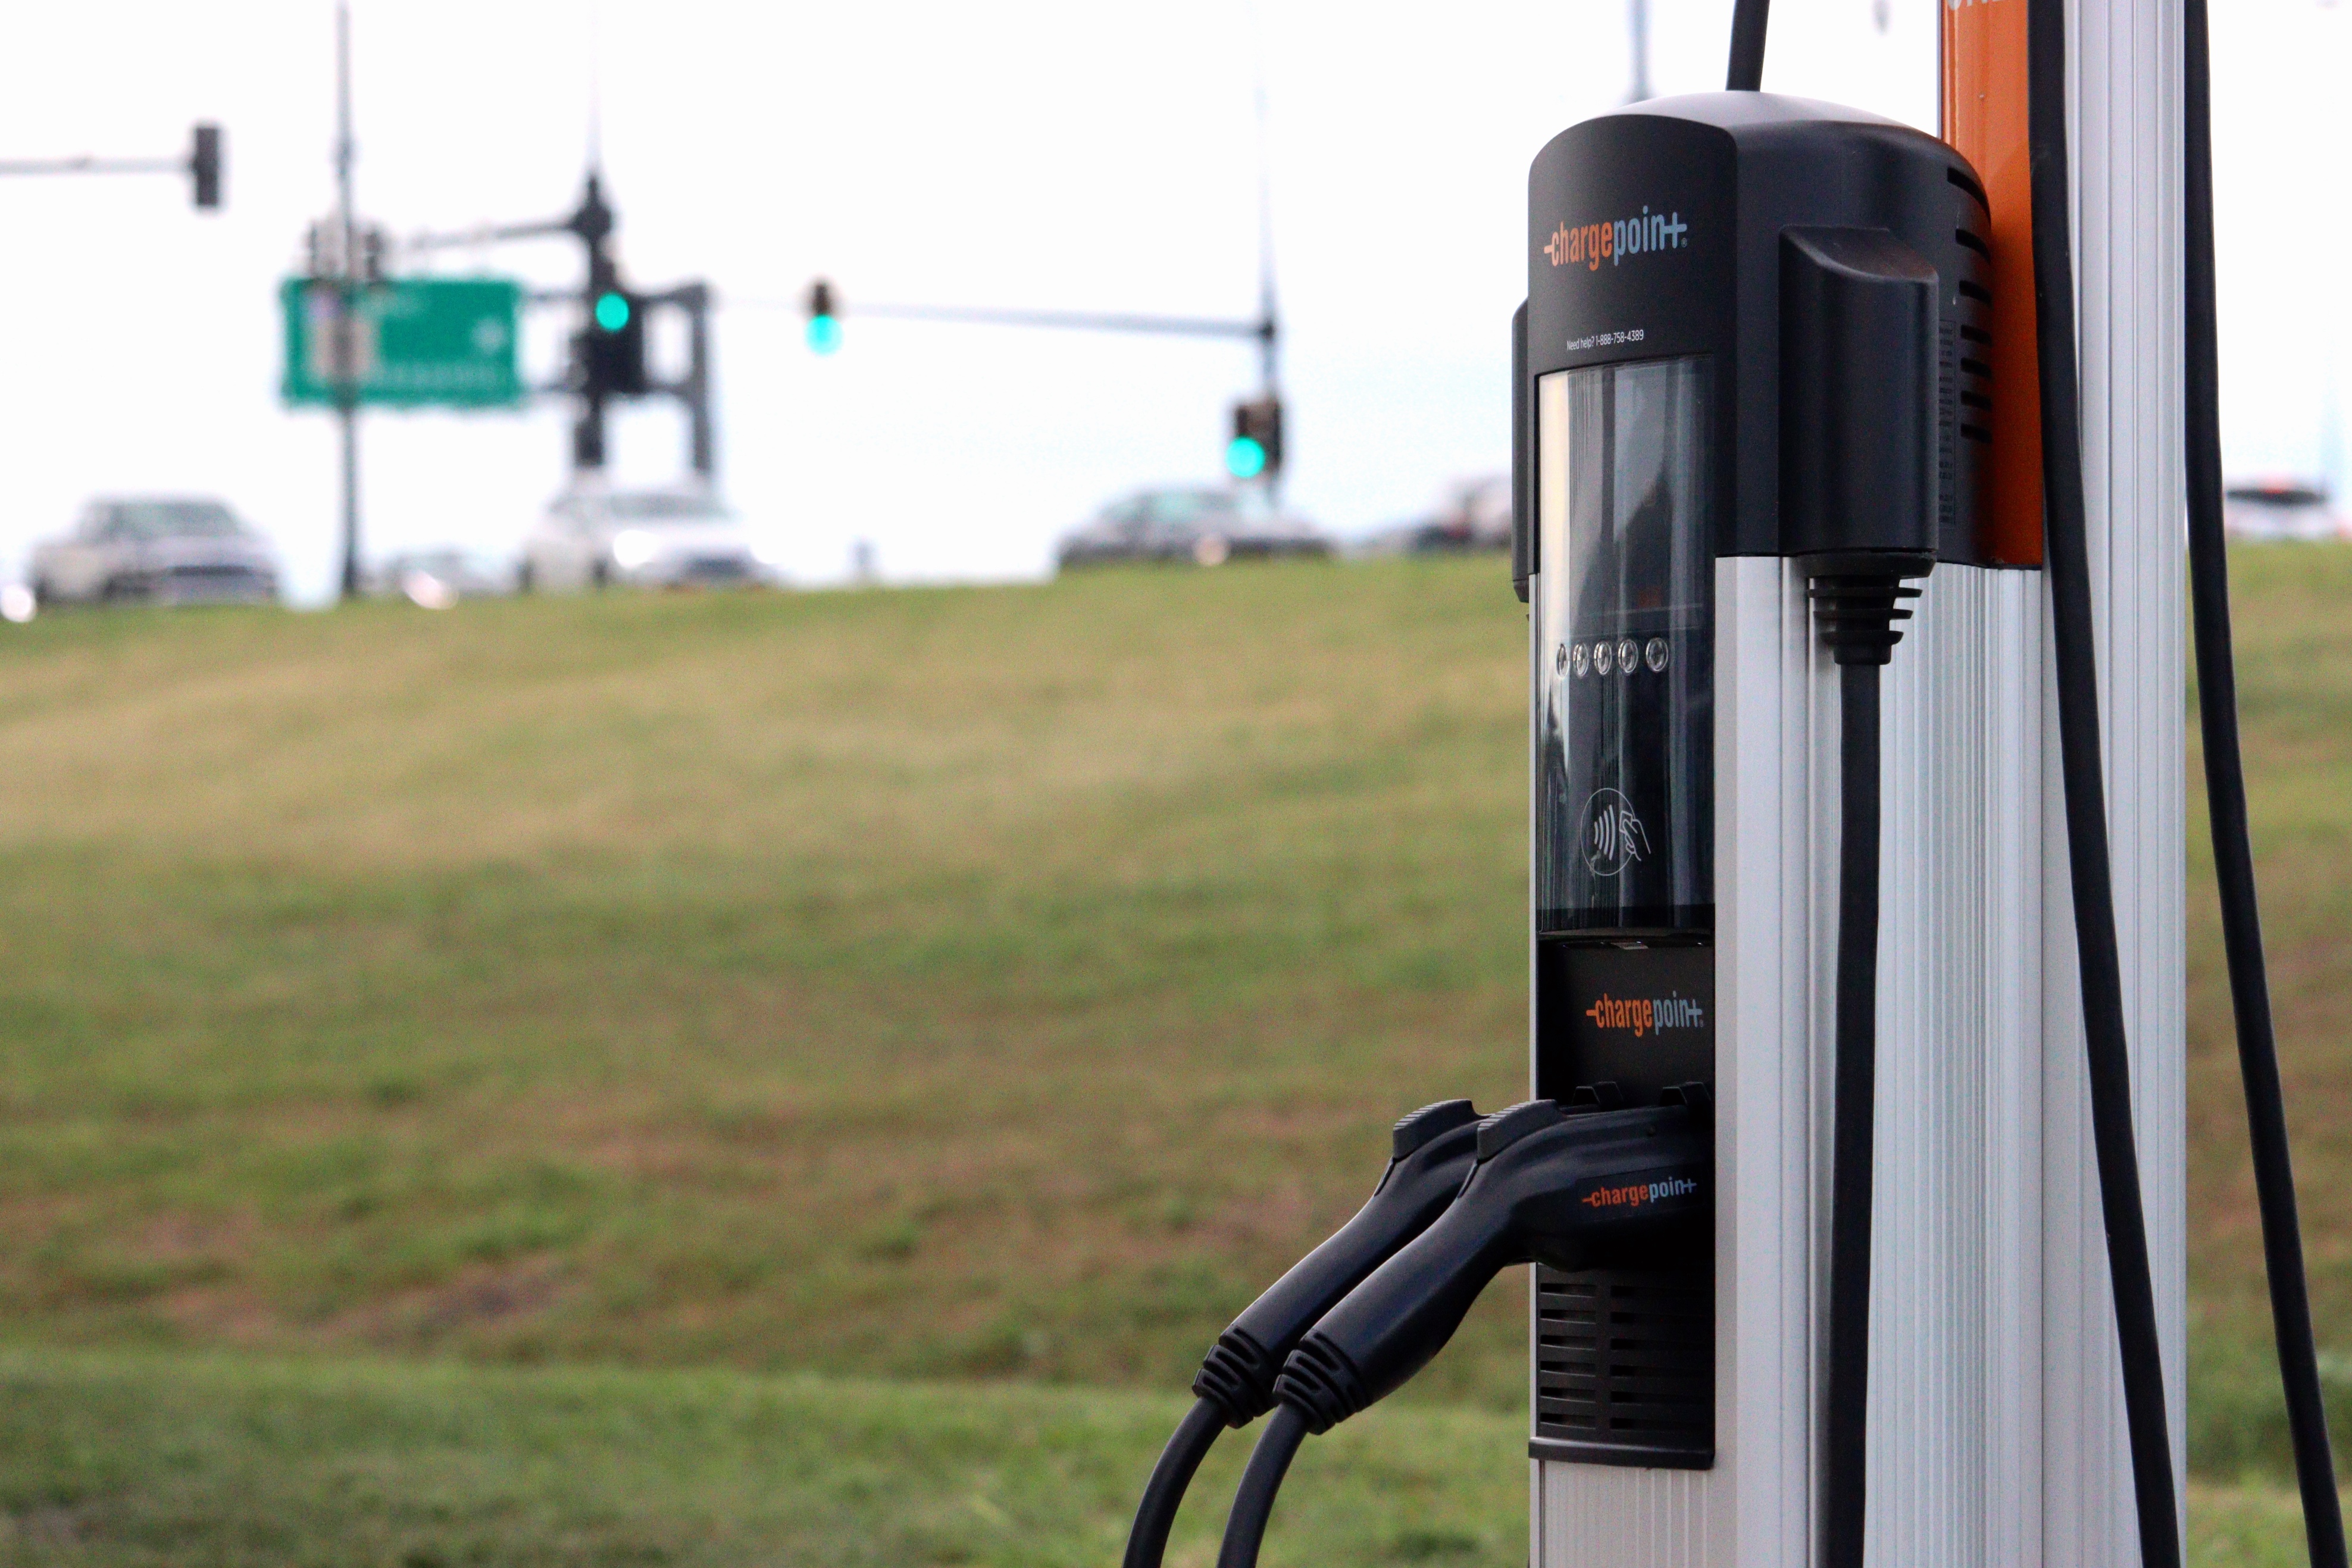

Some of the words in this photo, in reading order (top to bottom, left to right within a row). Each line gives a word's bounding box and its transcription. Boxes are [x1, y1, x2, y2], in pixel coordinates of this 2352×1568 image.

[1566, 339, 1580, 350] Need
[1580, 336, 1594, 349] help?
[1596, 329, 1644, 346] 1-888-758-4389
